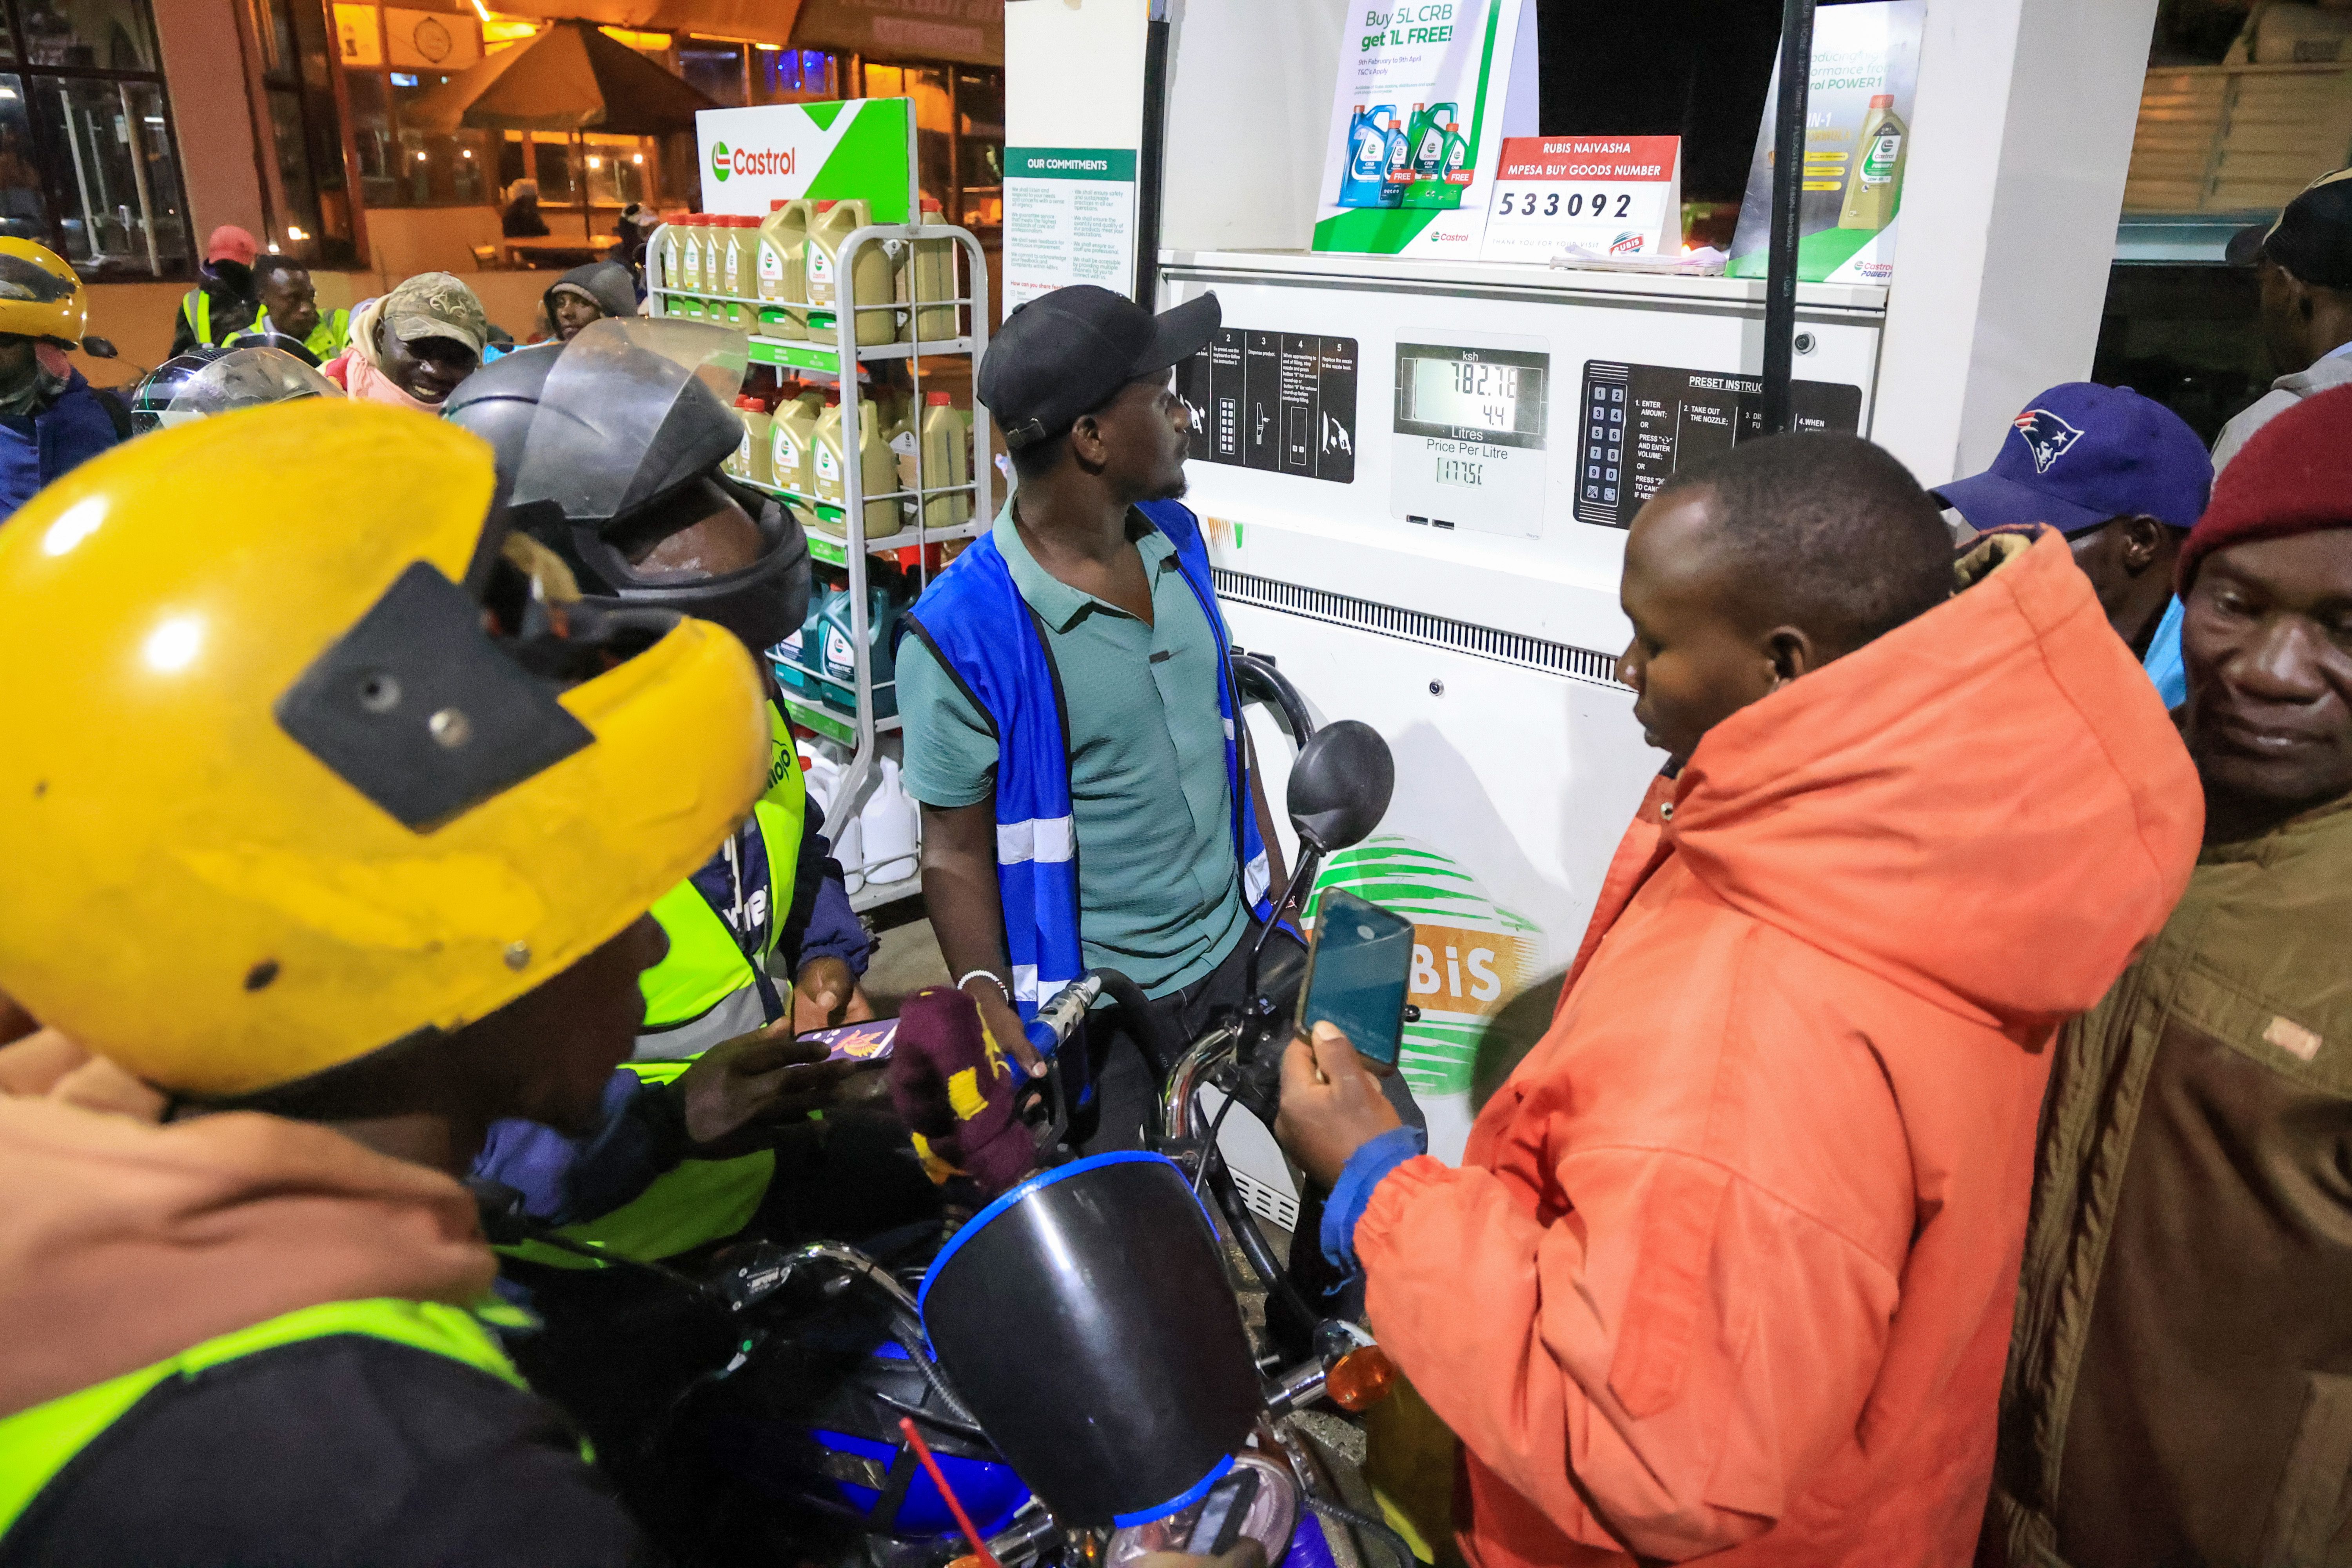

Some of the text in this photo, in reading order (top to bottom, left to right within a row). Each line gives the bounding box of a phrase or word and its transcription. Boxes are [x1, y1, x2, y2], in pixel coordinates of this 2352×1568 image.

[1366, 4, 1452, 29] Buy 5L CRB
[1361, 25, 1453, 51] get 1L FREE!
[1811, 52, 1857, 63] oducing
[1810, 66, 1863, 76] ormance
[1807, 112, 1832, 128] IN-1
[1543, 143, 1631, 153] RUBIS NAIVASHA
[734, 147, 795, 175] Castrol
[1027, 158, 1107, 170] OUR COMMITMENTS
[1508, 165, 1661, 176] MPESA BUY GOODS NUMBER
[1440, 233, 1468, 242] Castrol
[1261, 337, 1266, 345] 3
[1337, 343, 1342, 352] 5
[1463, 351, 1478, 361] ksh
[1689, 376, 1762, 392] PRESET INSTRUC
[1641, 409, 1667, 418] AMOUNT;
[1691, 406, 1706, 414] TAKE
[1703, 416, 1728, 426] NOZZLE;
[1452, 425, 1483, 441] Litres
[1639, 434, 1657, 442] PRESS
[1427, 439, 1508, 459] Price Per Litre
[1638, 450, 1663, 460] VOLUME;
[1636, 475, 1654, 483] PRESS
[1411, 944, 1501, 1002] BiS
